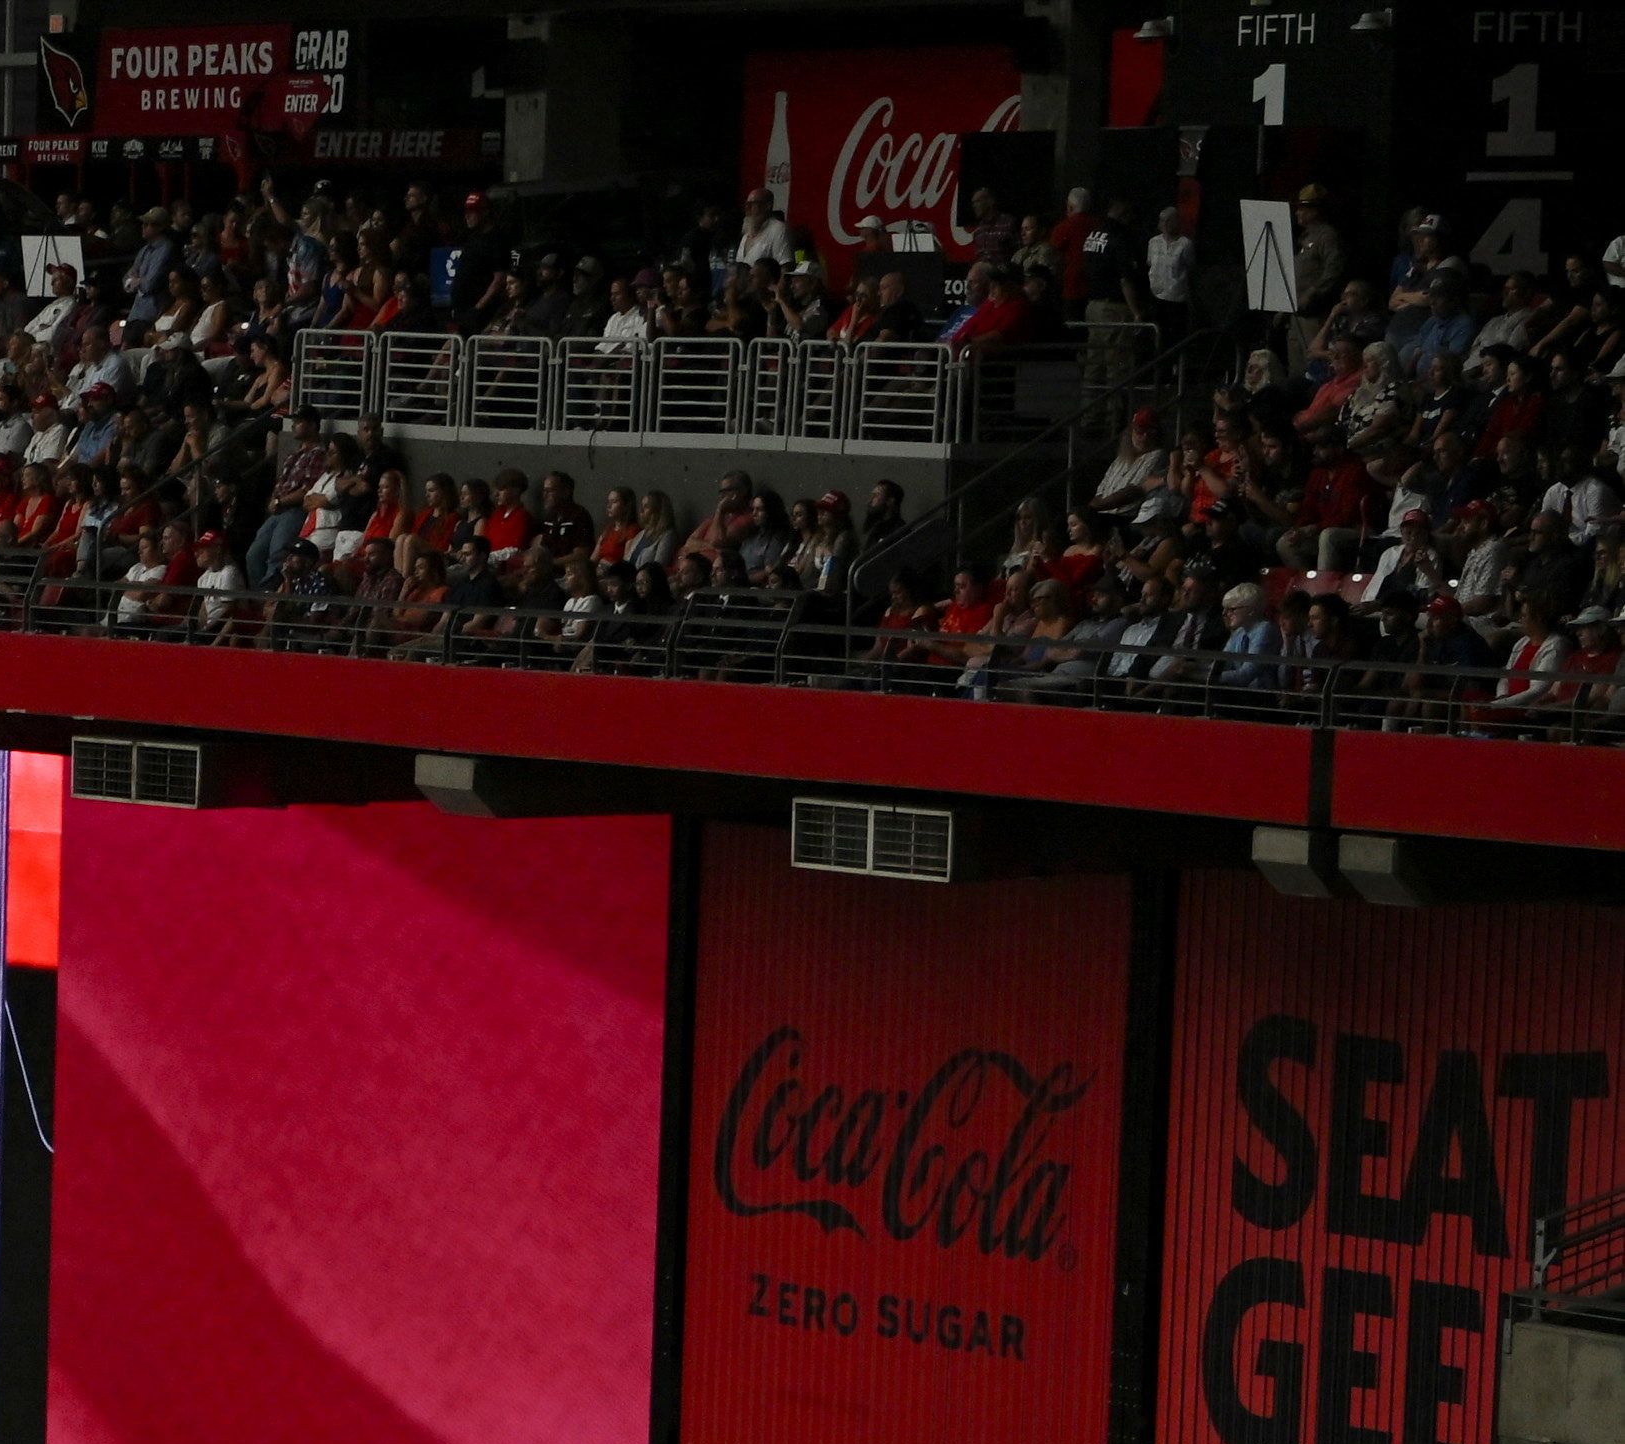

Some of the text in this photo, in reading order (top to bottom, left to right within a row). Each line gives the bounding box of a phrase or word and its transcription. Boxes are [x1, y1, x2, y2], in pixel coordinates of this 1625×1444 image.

[1237, 13, 1315, 46] FIFTH
[1472, 11, 1584, 44] FIFTH
[110, 41, 274, 79] FOUR PEAKS
[295, 29, 349, 71] GRAB
[140, 86, 242, 111] BREWING
[284, 94, 318, 113] ENTER
[1252, 63, 1287, 126] 1
[1486, 63, 1557, 158] 1
[28, 140, 79, 151] FOUR PEAKS
[37, 153, 69, 162] BREWING
[314, 129, 445, 158] ENTER HERE
[1469, 198, 1550, 277] 4
[713, 1025, 1102, 1263] Coca-Cola
[1233, 1013, 1608, 1259] SEAT
[750, 1272, 1029, 1361] ZERO SUGAR
